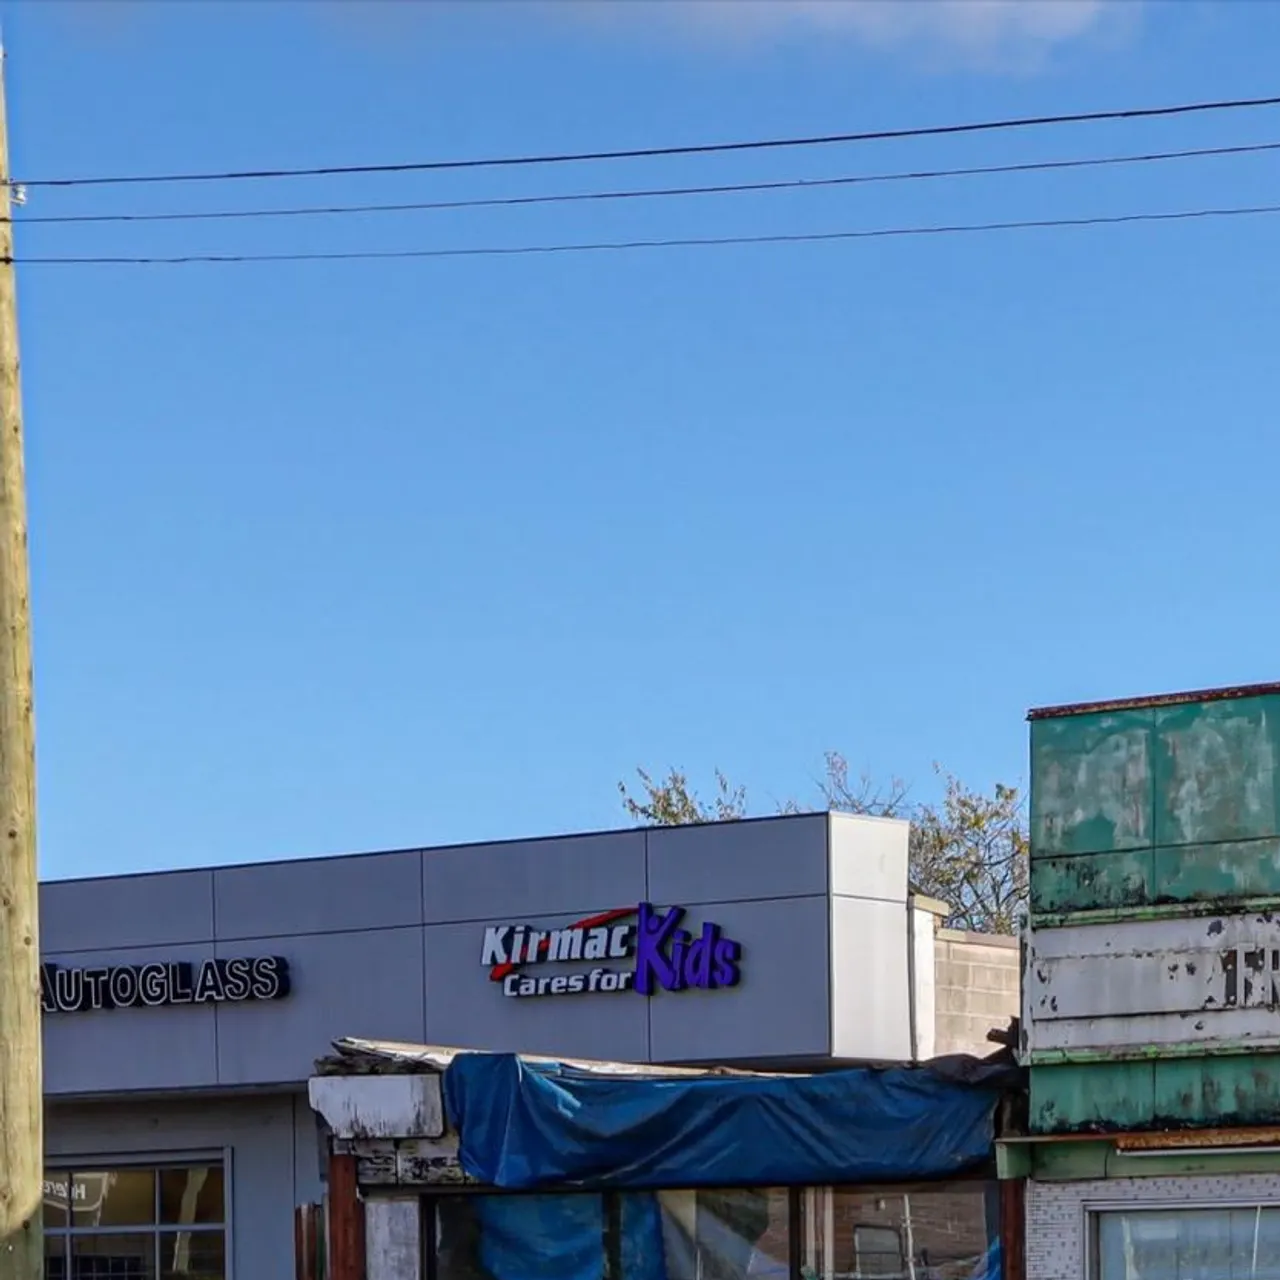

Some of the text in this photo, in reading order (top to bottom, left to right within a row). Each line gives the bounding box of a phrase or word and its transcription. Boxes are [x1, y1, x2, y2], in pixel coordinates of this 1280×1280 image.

[481, 902, 741, 996] Kirmac Kids
[503, 967, 632, 997] Cares for
